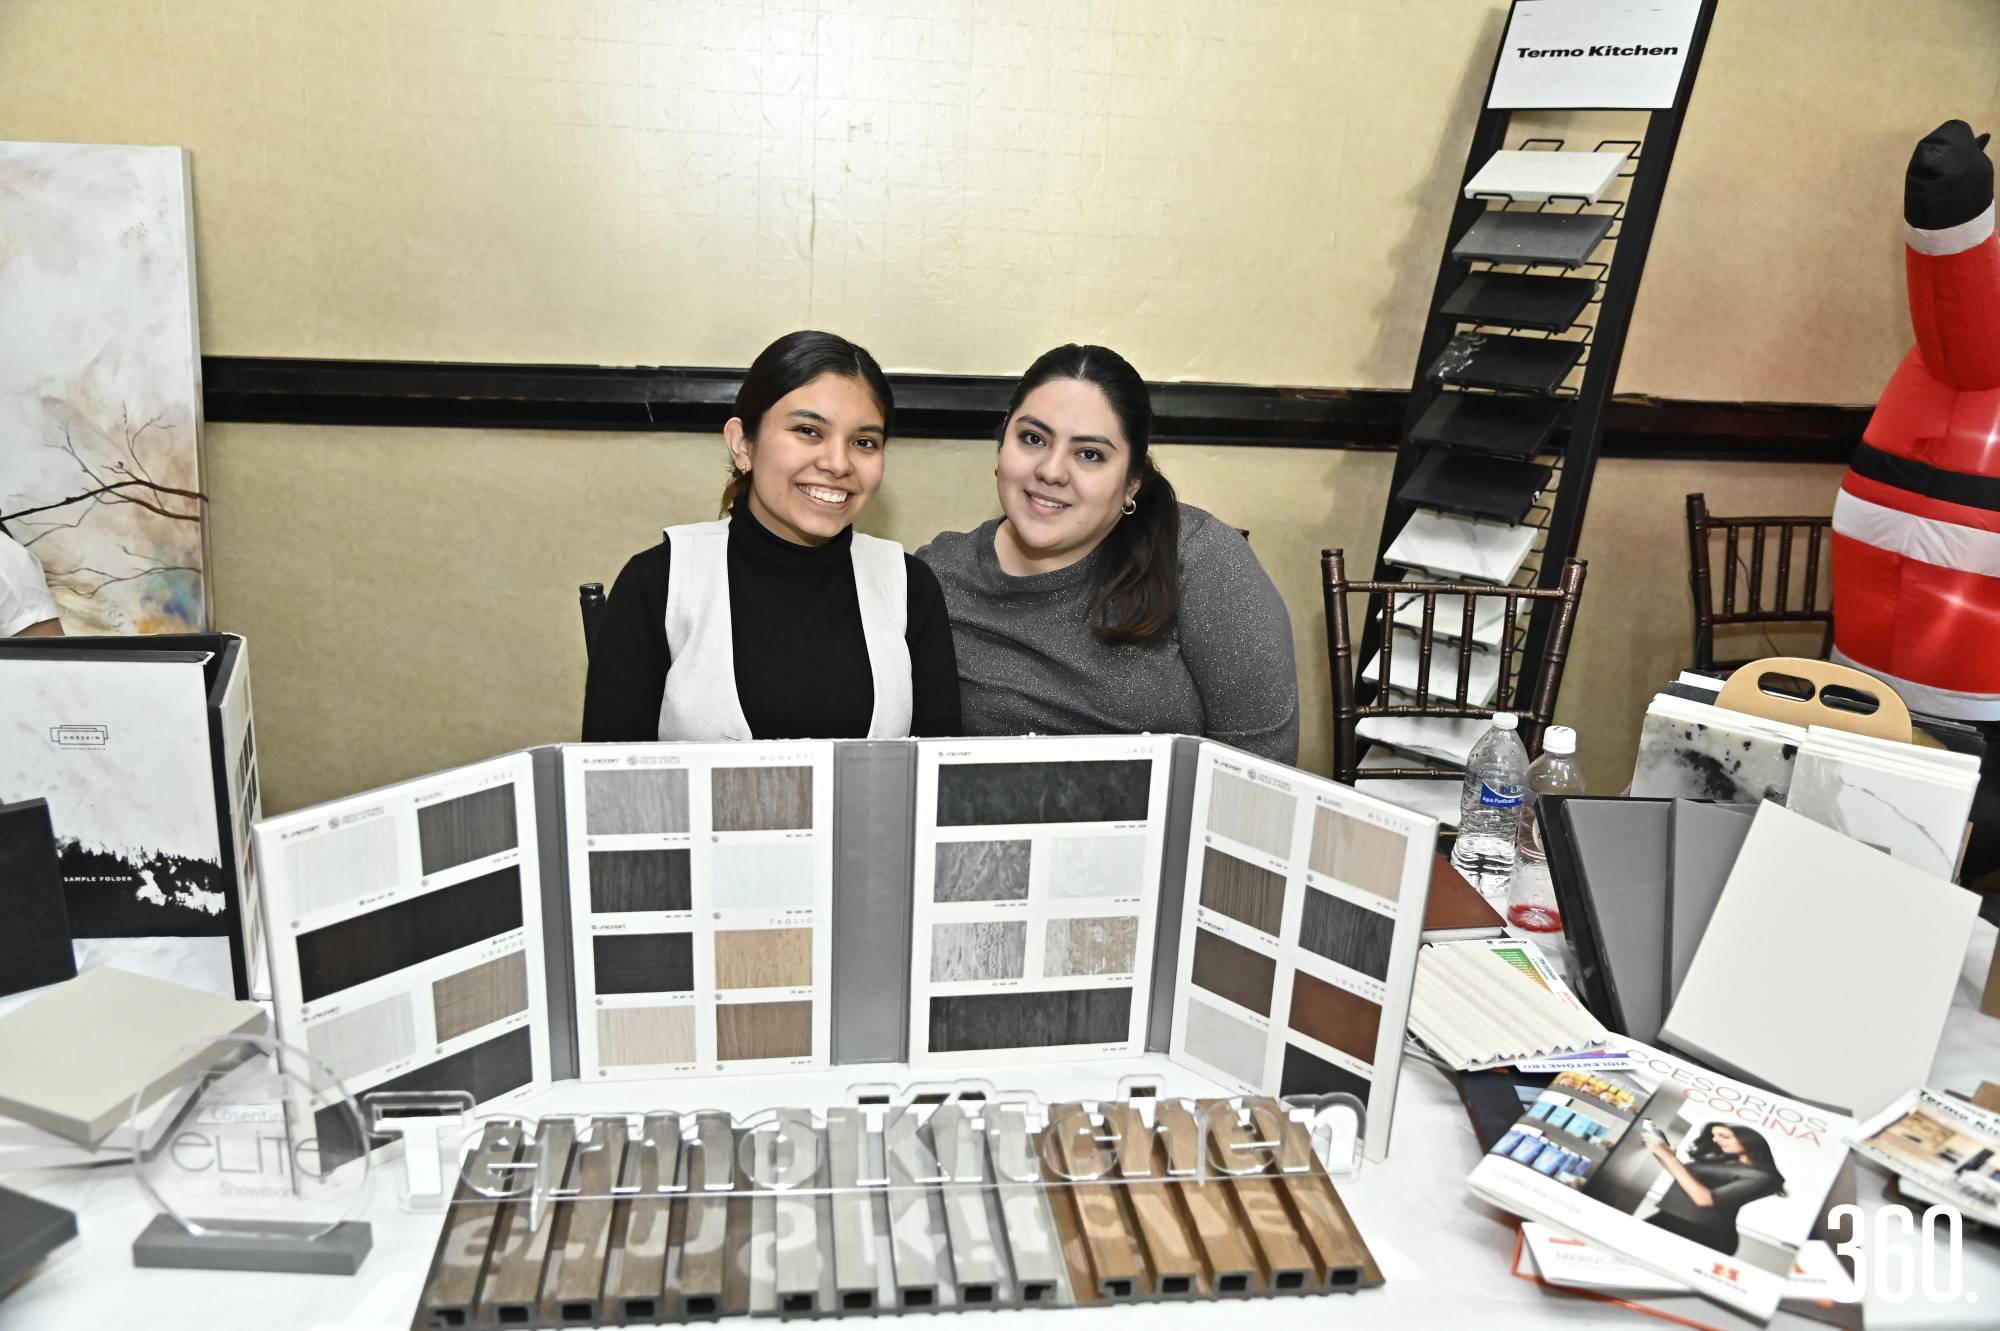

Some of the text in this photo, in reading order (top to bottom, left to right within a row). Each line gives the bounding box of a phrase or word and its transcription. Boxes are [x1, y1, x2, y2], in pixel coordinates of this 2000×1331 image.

[1517, 45, 1678, 58] Termo Kitchen
[1683, 1088, 1821, 1147] COCINA
